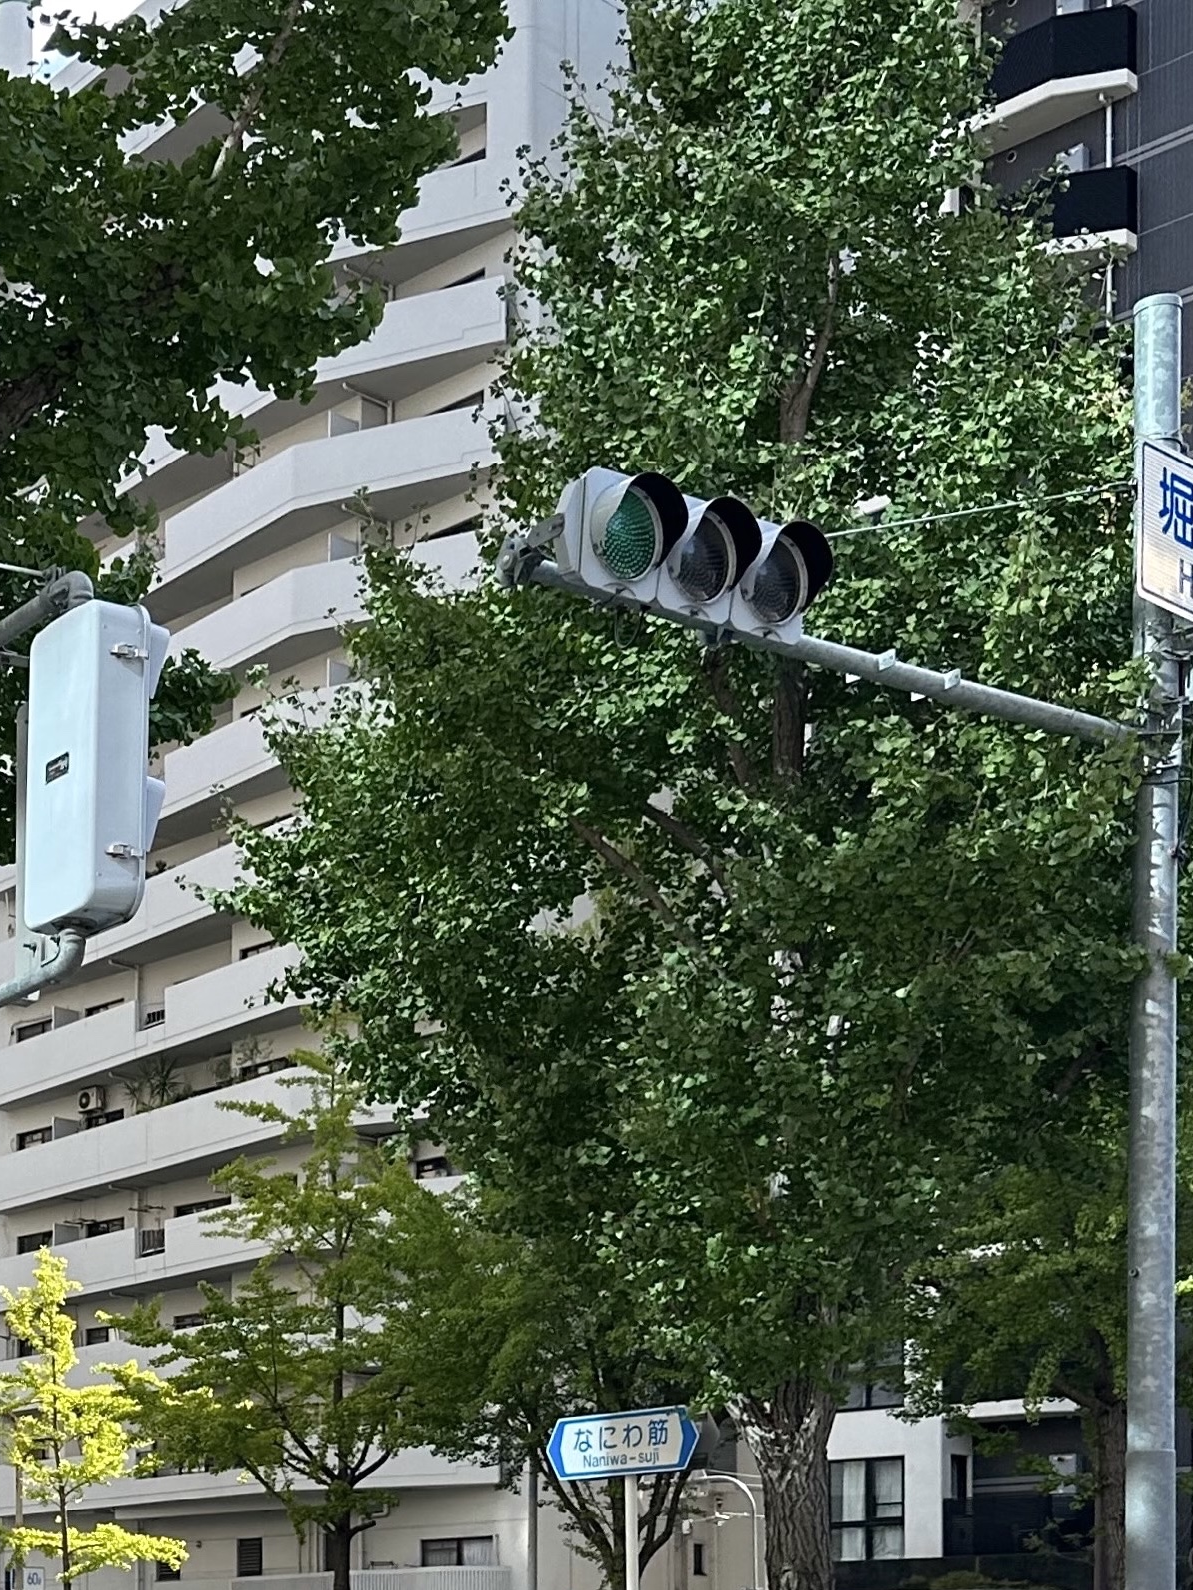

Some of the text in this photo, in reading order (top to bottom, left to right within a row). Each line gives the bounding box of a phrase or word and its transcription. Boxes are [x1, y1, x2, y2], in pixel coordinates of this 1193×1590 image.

[1159, 467, 1193, 550] 堀
[574, 1418, 669, 1453] なにわ筋
[583, 1448, 659, 1468] Naniwa-suji
